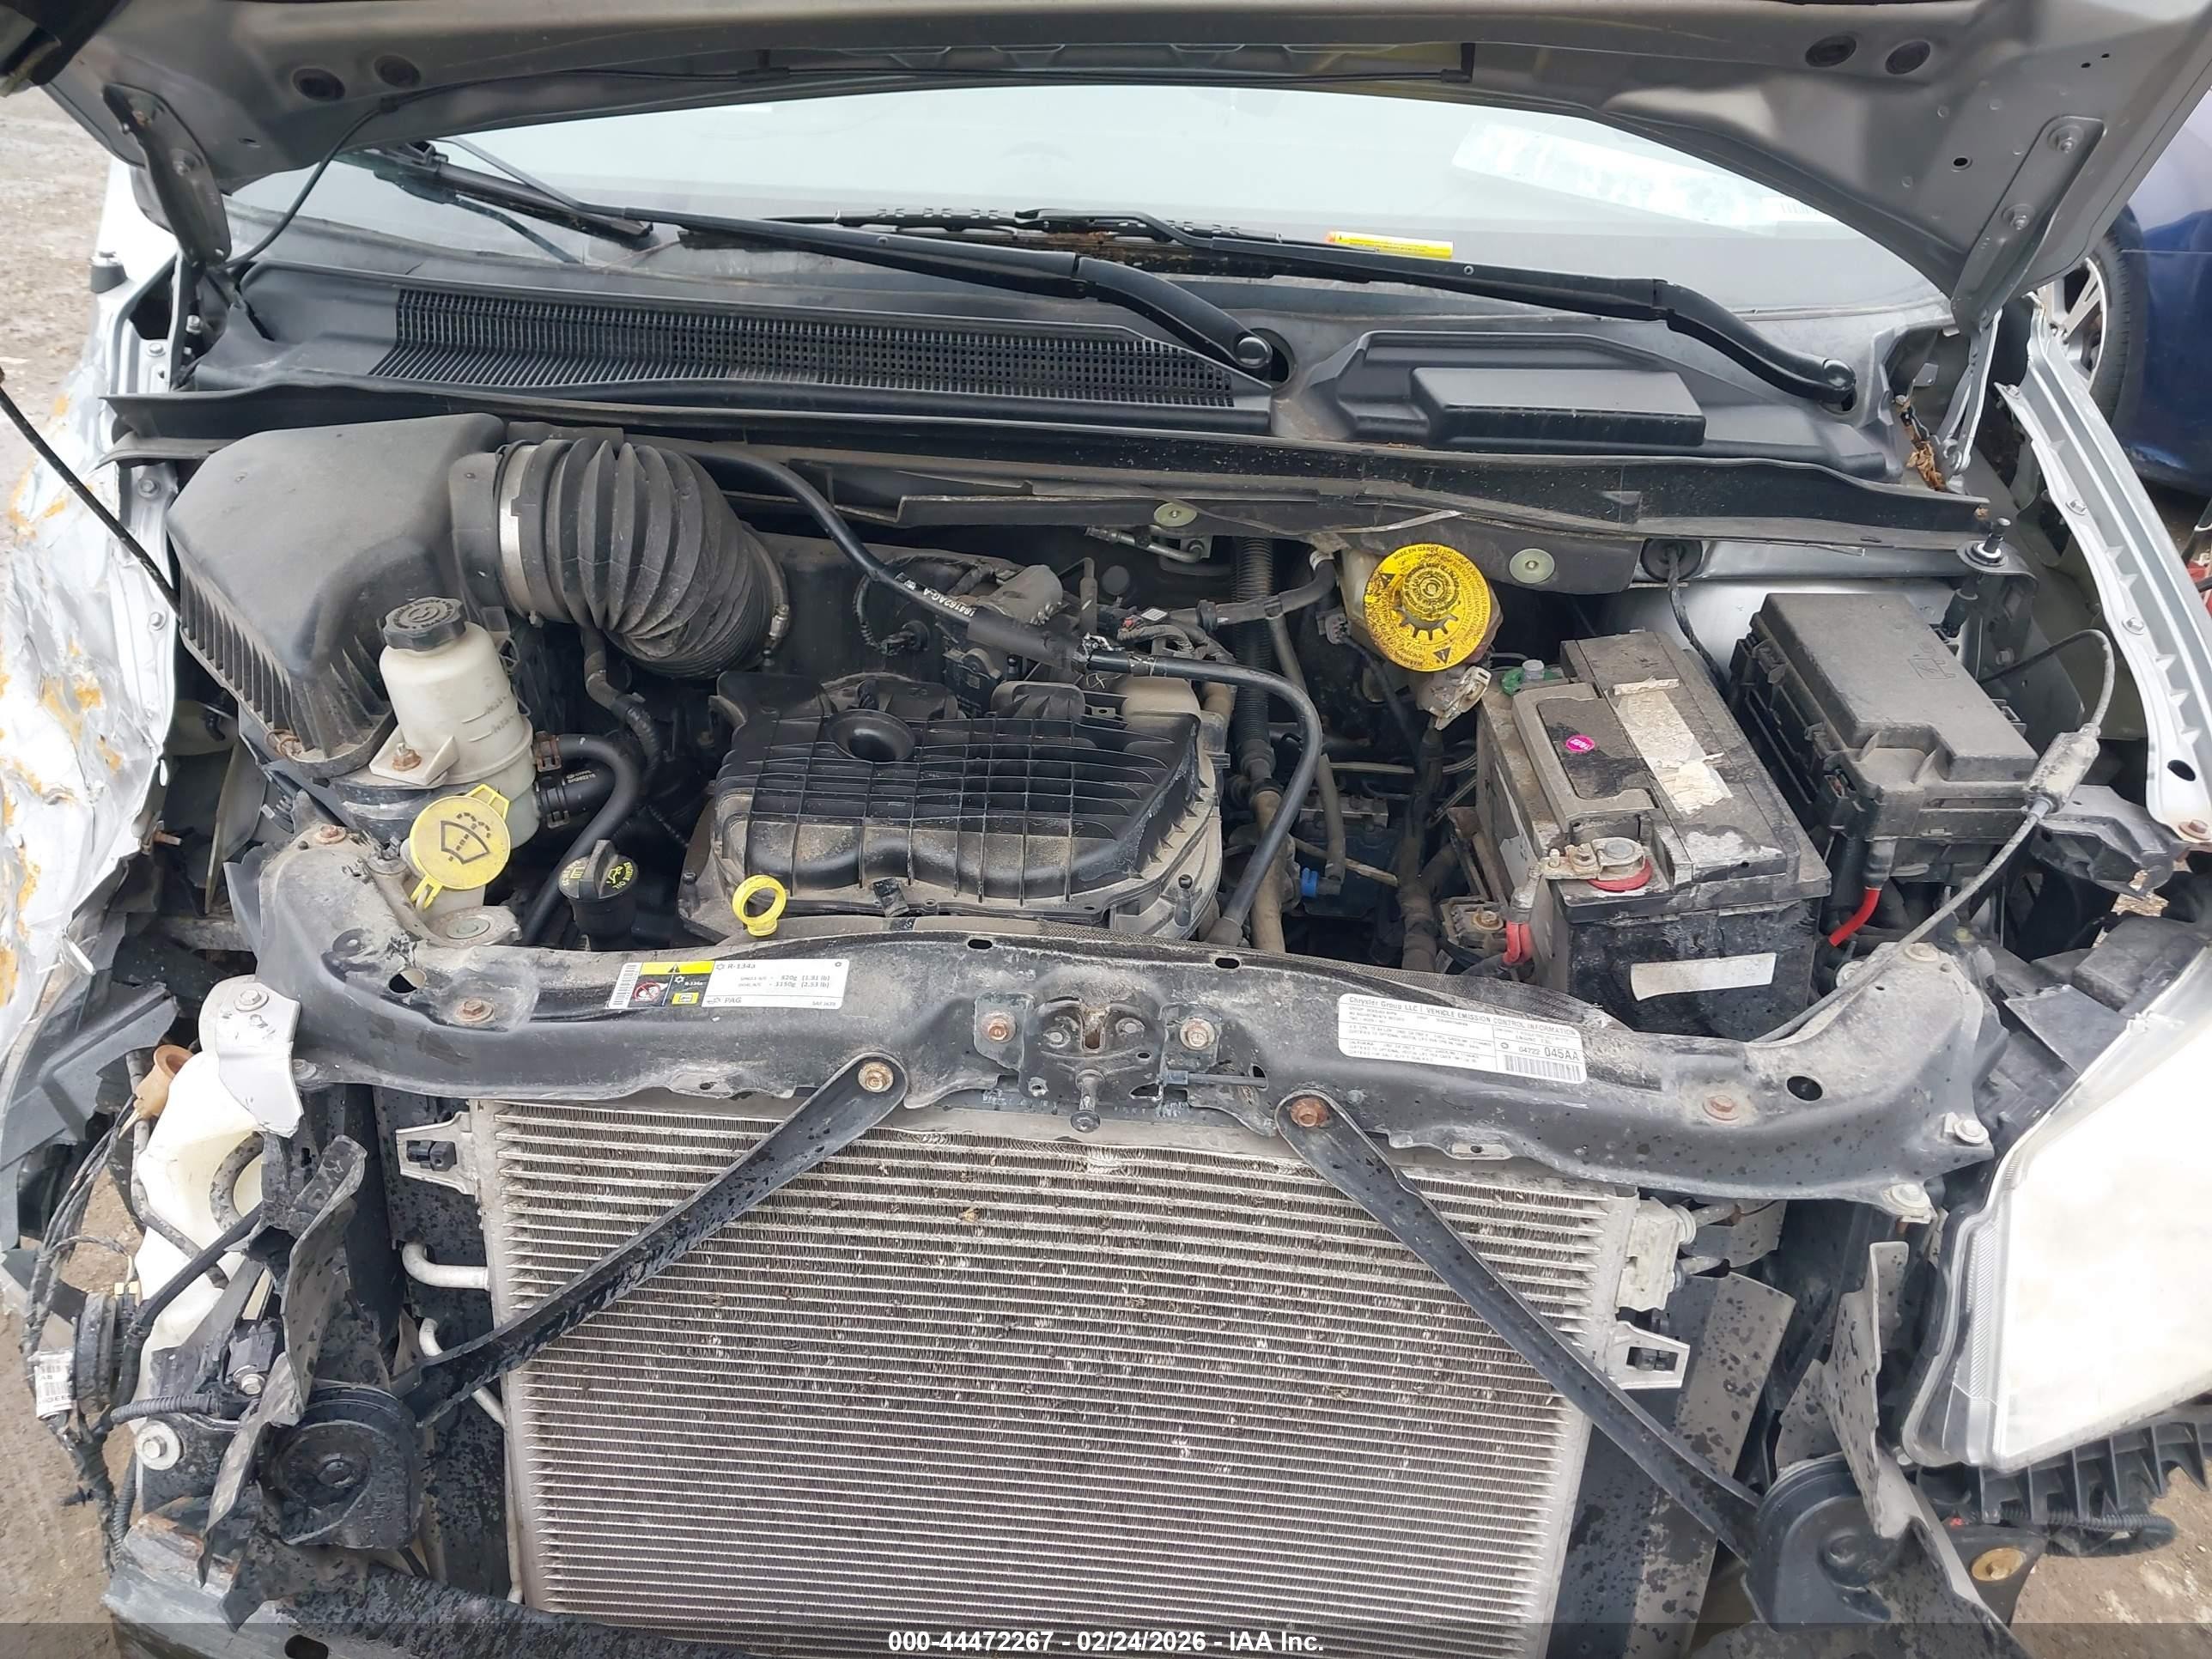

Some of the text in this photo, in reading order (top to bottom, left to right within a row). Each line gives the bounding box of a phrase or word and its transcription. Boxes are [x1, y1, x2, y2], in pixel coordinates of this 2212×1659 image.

[611, 861, 634, 890] ENGINE OIL
[1349, 996, 1378, 1006] Chrysler
[1381, 1000, 1402, 1010] Group
[1404, 1004, 1418, 1012] LLC
[1426, 1007, 1457, 1018] VEHICLE
[1457, 1012, 1491, 1023] EMISSION
[1493, 1017, 1526, 1029] CONTROL
[1527, 1023, 1577, 1036] INFORMATION
[1518, 1046, 1581, 1061] 04722 045AA
